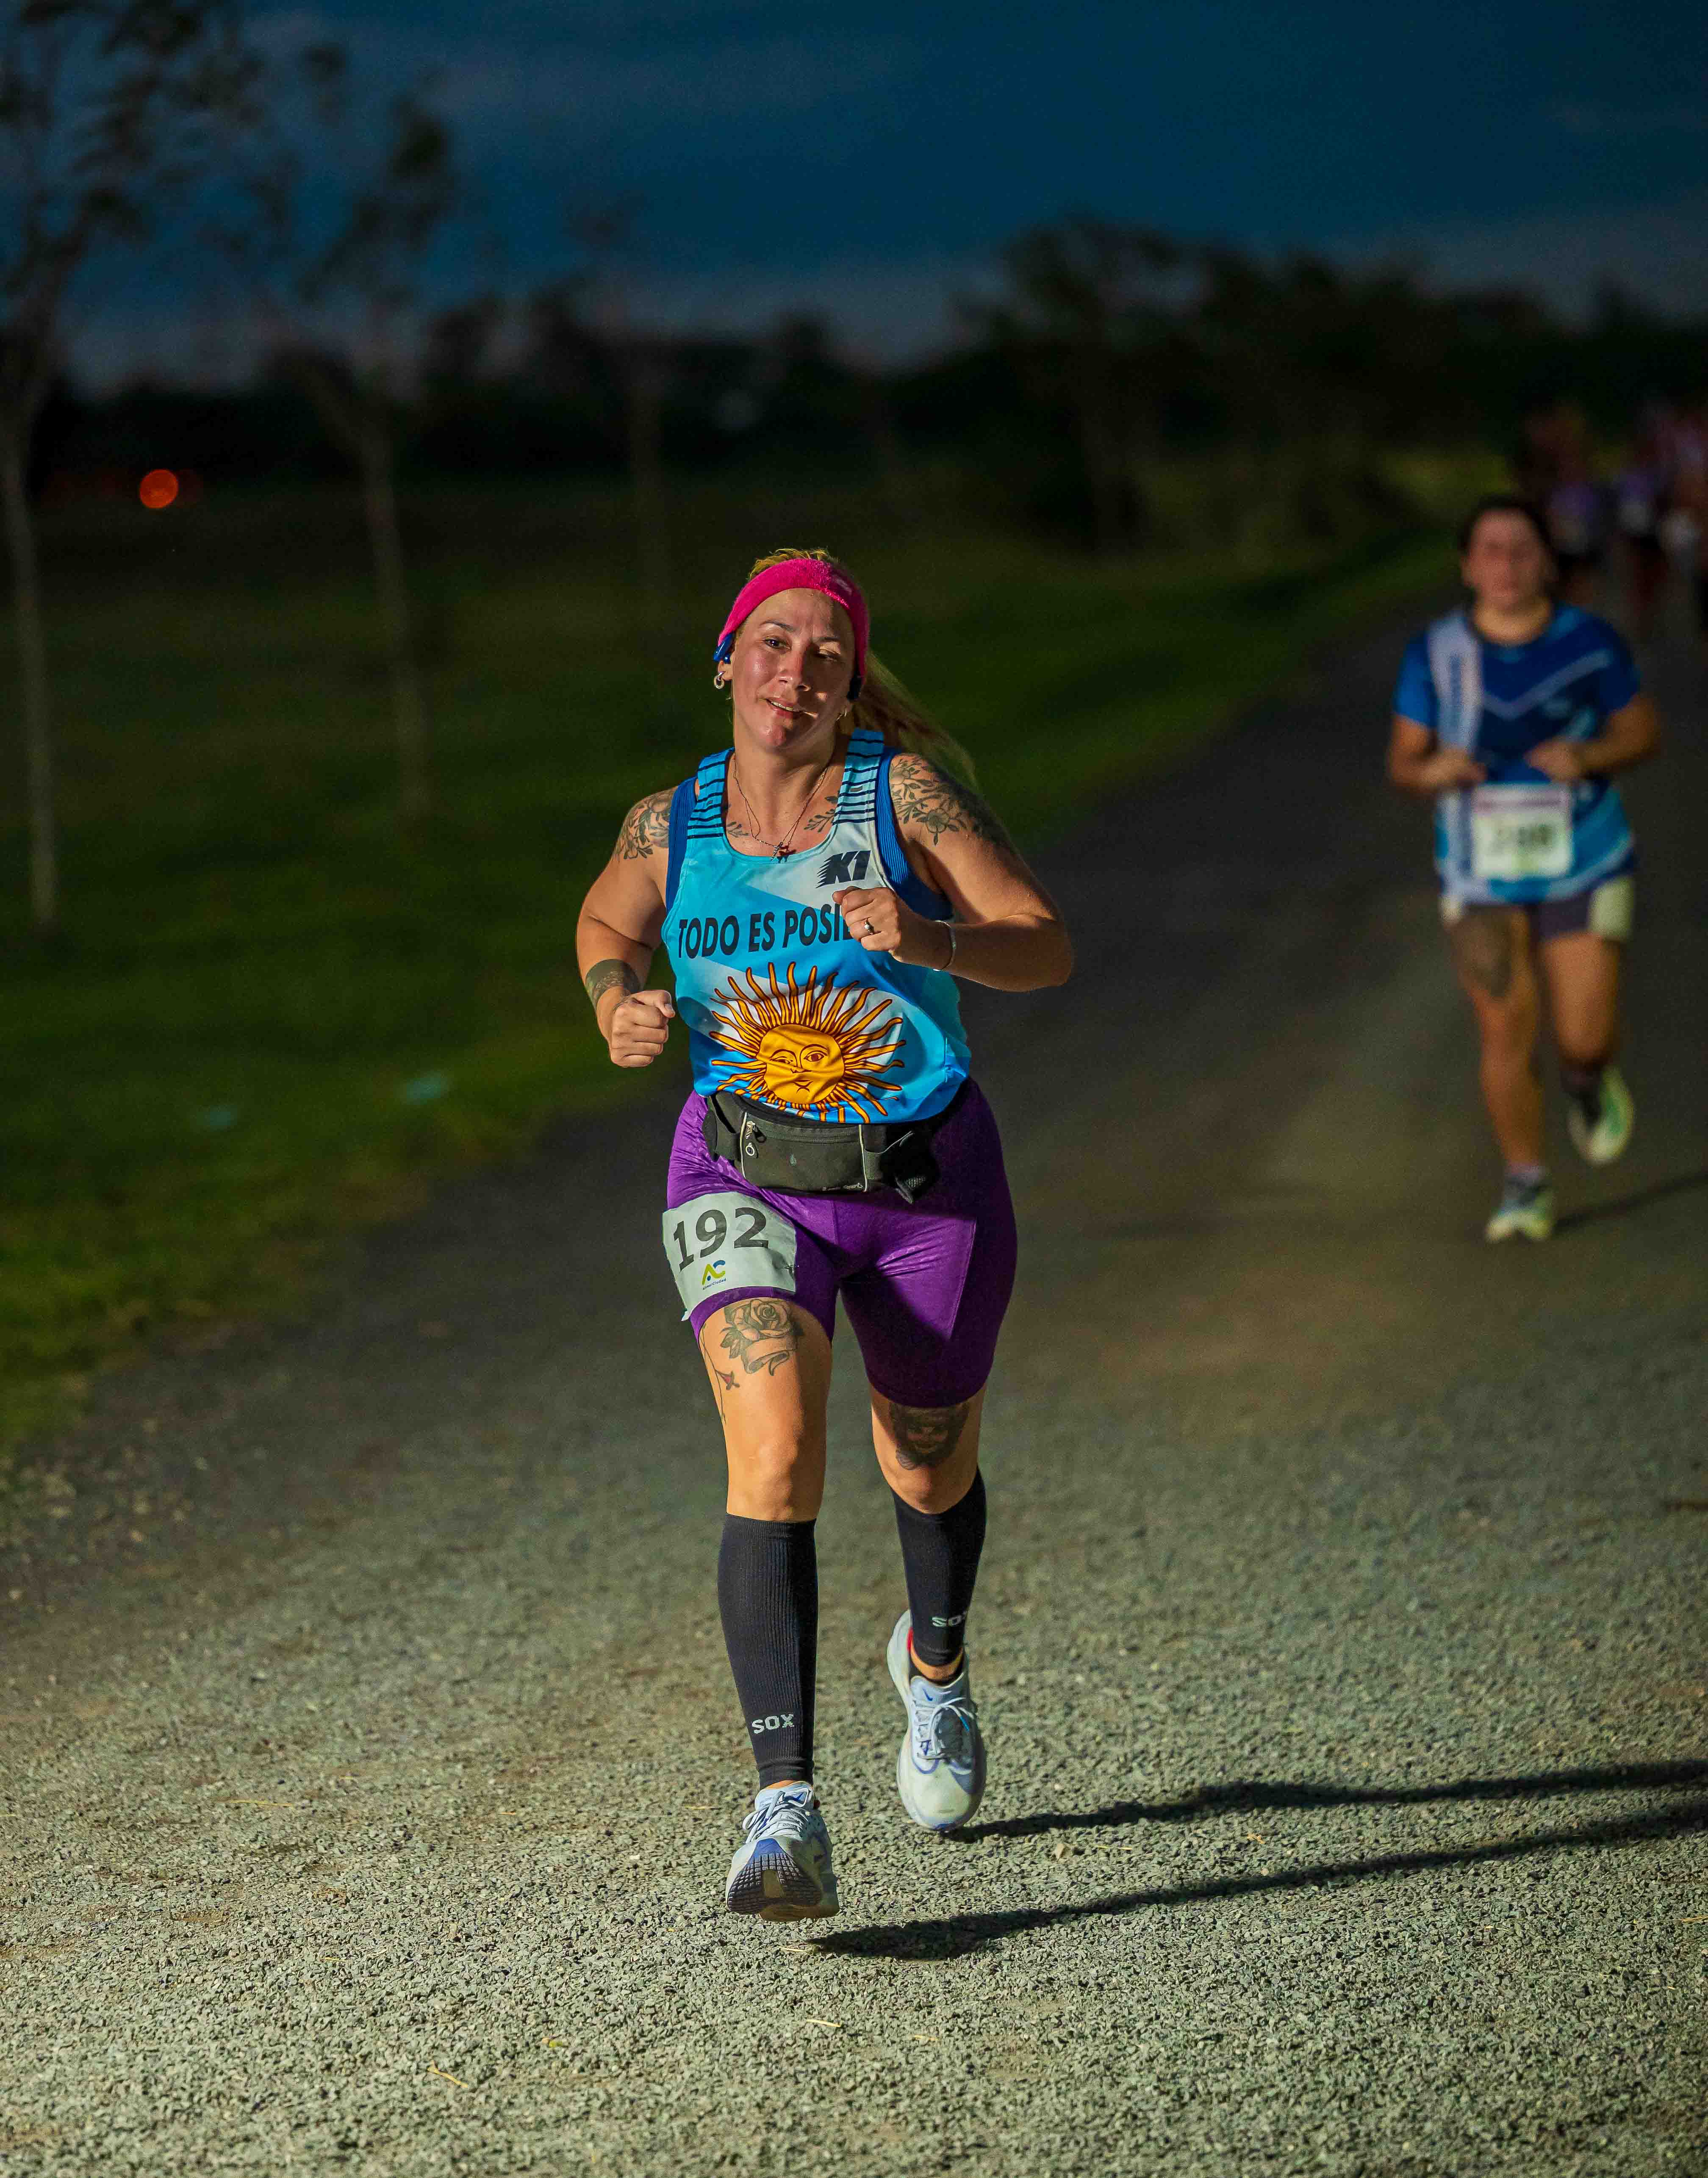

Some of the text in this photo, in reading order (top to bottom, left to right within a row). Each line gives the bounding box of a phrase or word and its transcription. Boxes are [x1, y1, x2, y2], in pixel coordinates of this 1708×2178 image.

[679, 916, 739, 959] TODO
[749, 912, 775, 952] ES
[673, 1207, 768, 1271] 192
[932, 1611, 967, 1627] SO
[752, 1714, 795, 1734] SOX
